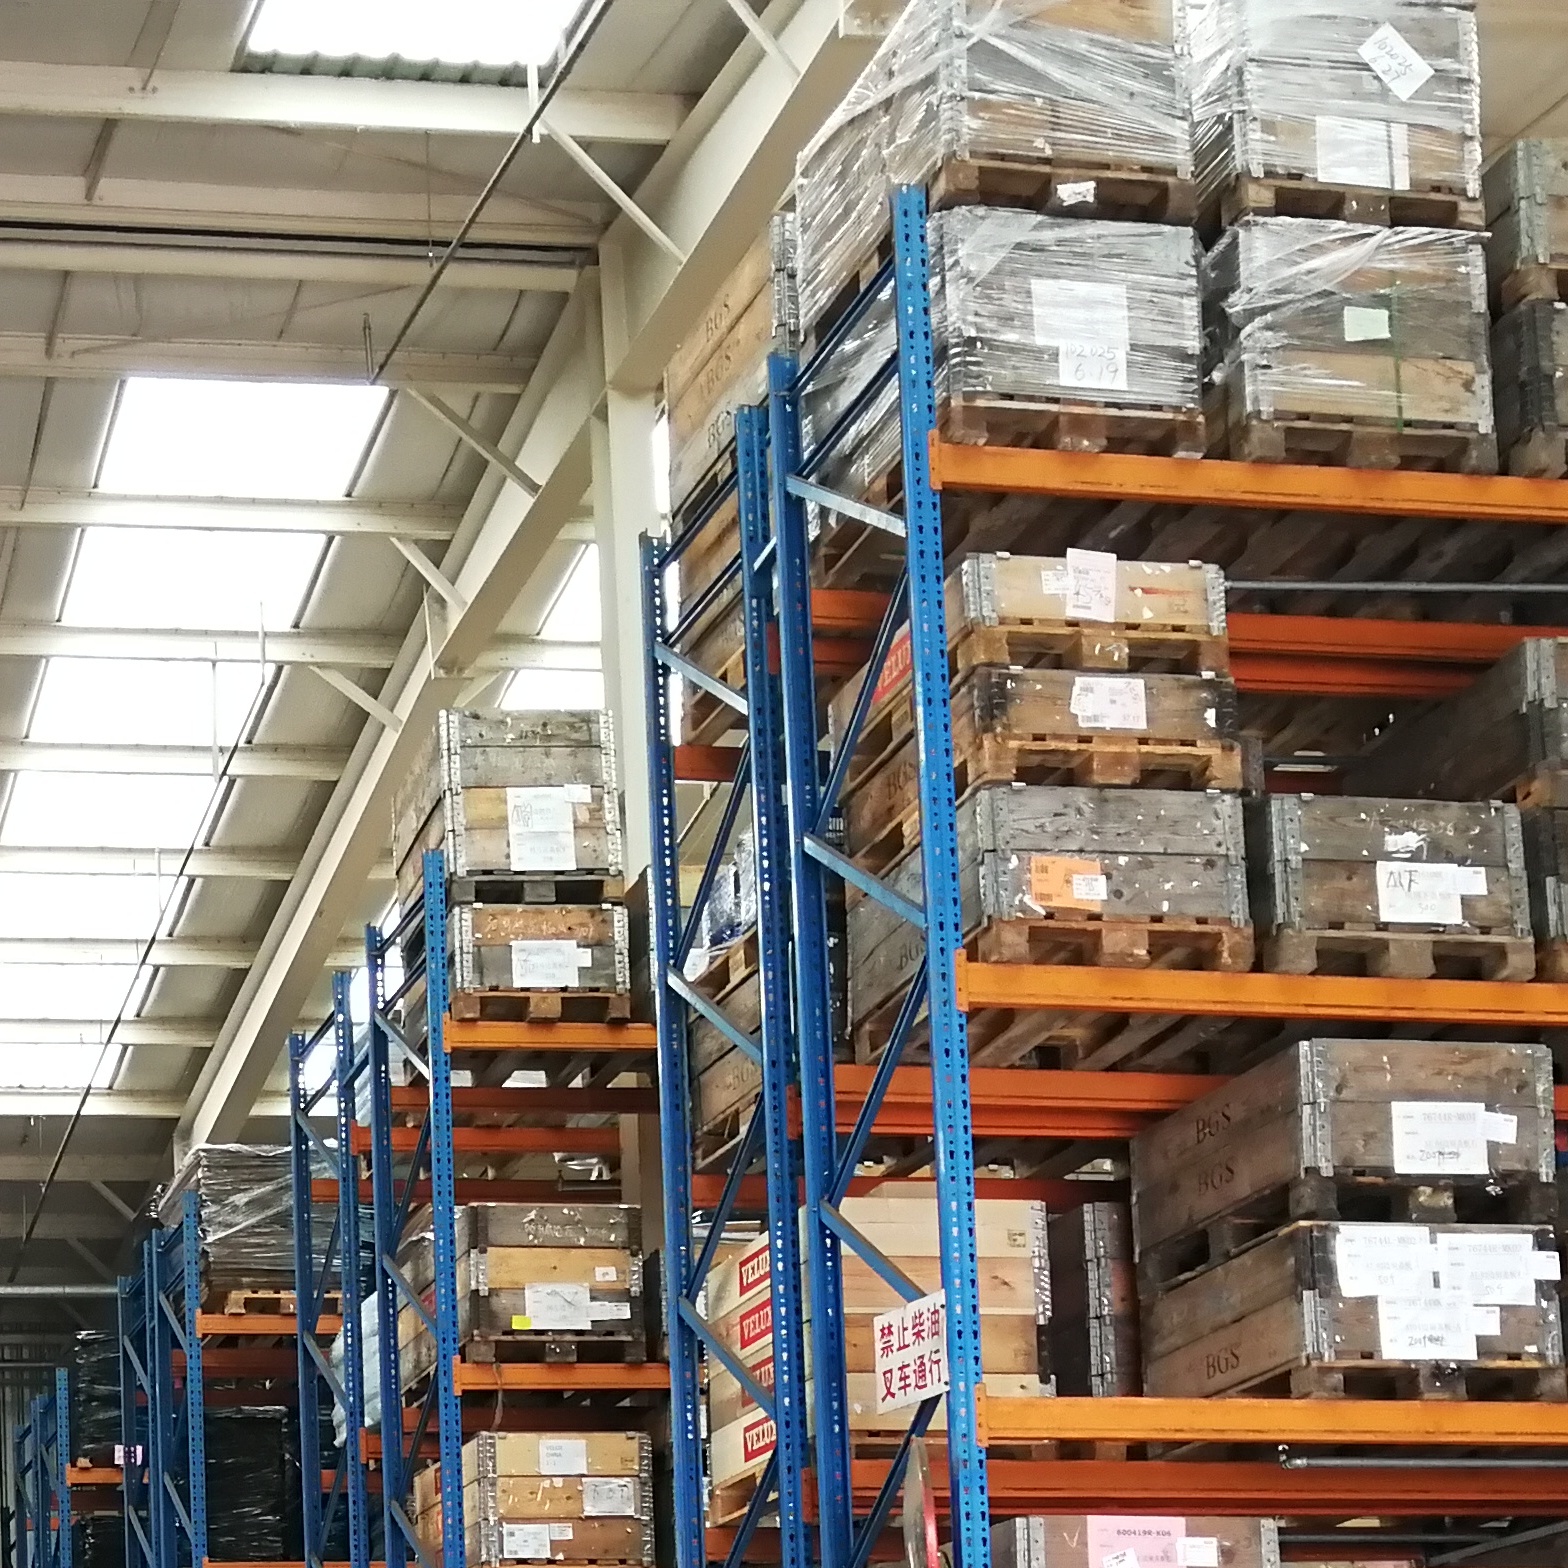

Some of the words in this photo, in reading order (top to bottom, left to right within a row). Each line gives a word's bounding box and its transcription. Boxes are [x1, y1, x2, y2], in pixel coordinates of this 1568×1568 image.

[1195, 1103, 1232, 1145] BGS
[1197, 1159, 1236, 1196] BGS
[879, 1302, 941, 1359] 禁止柴油
[880, 1348, 943, 1403] 叉车通行
[1205, 1347, 1241, 1380] BGS
